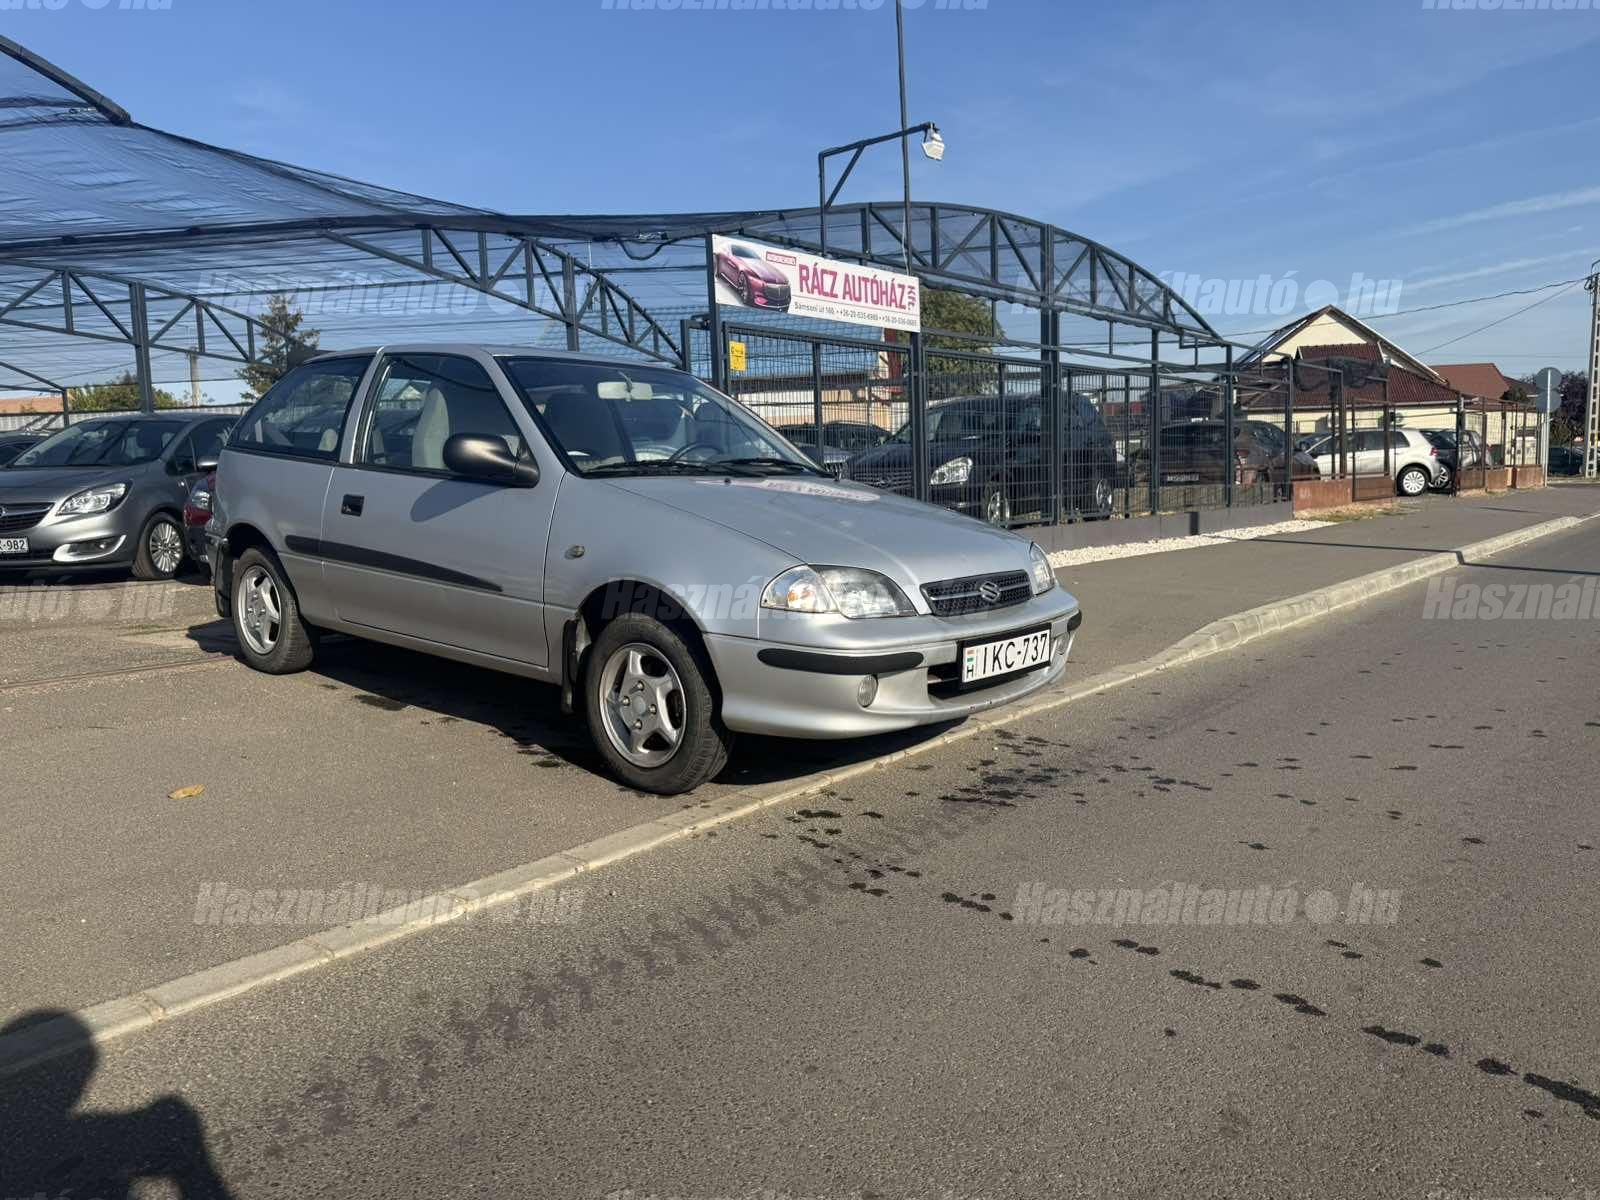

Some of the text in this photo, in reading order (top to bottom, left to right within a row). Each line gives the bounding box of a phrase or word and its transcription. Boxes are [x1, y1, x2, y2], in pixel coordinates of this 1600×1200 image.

[799, 262, 907, 311] RÁCZ AUTÓHÁZ
[966, 664, 974, 679] H
[983, 633, 1048, 674] IKC-737
